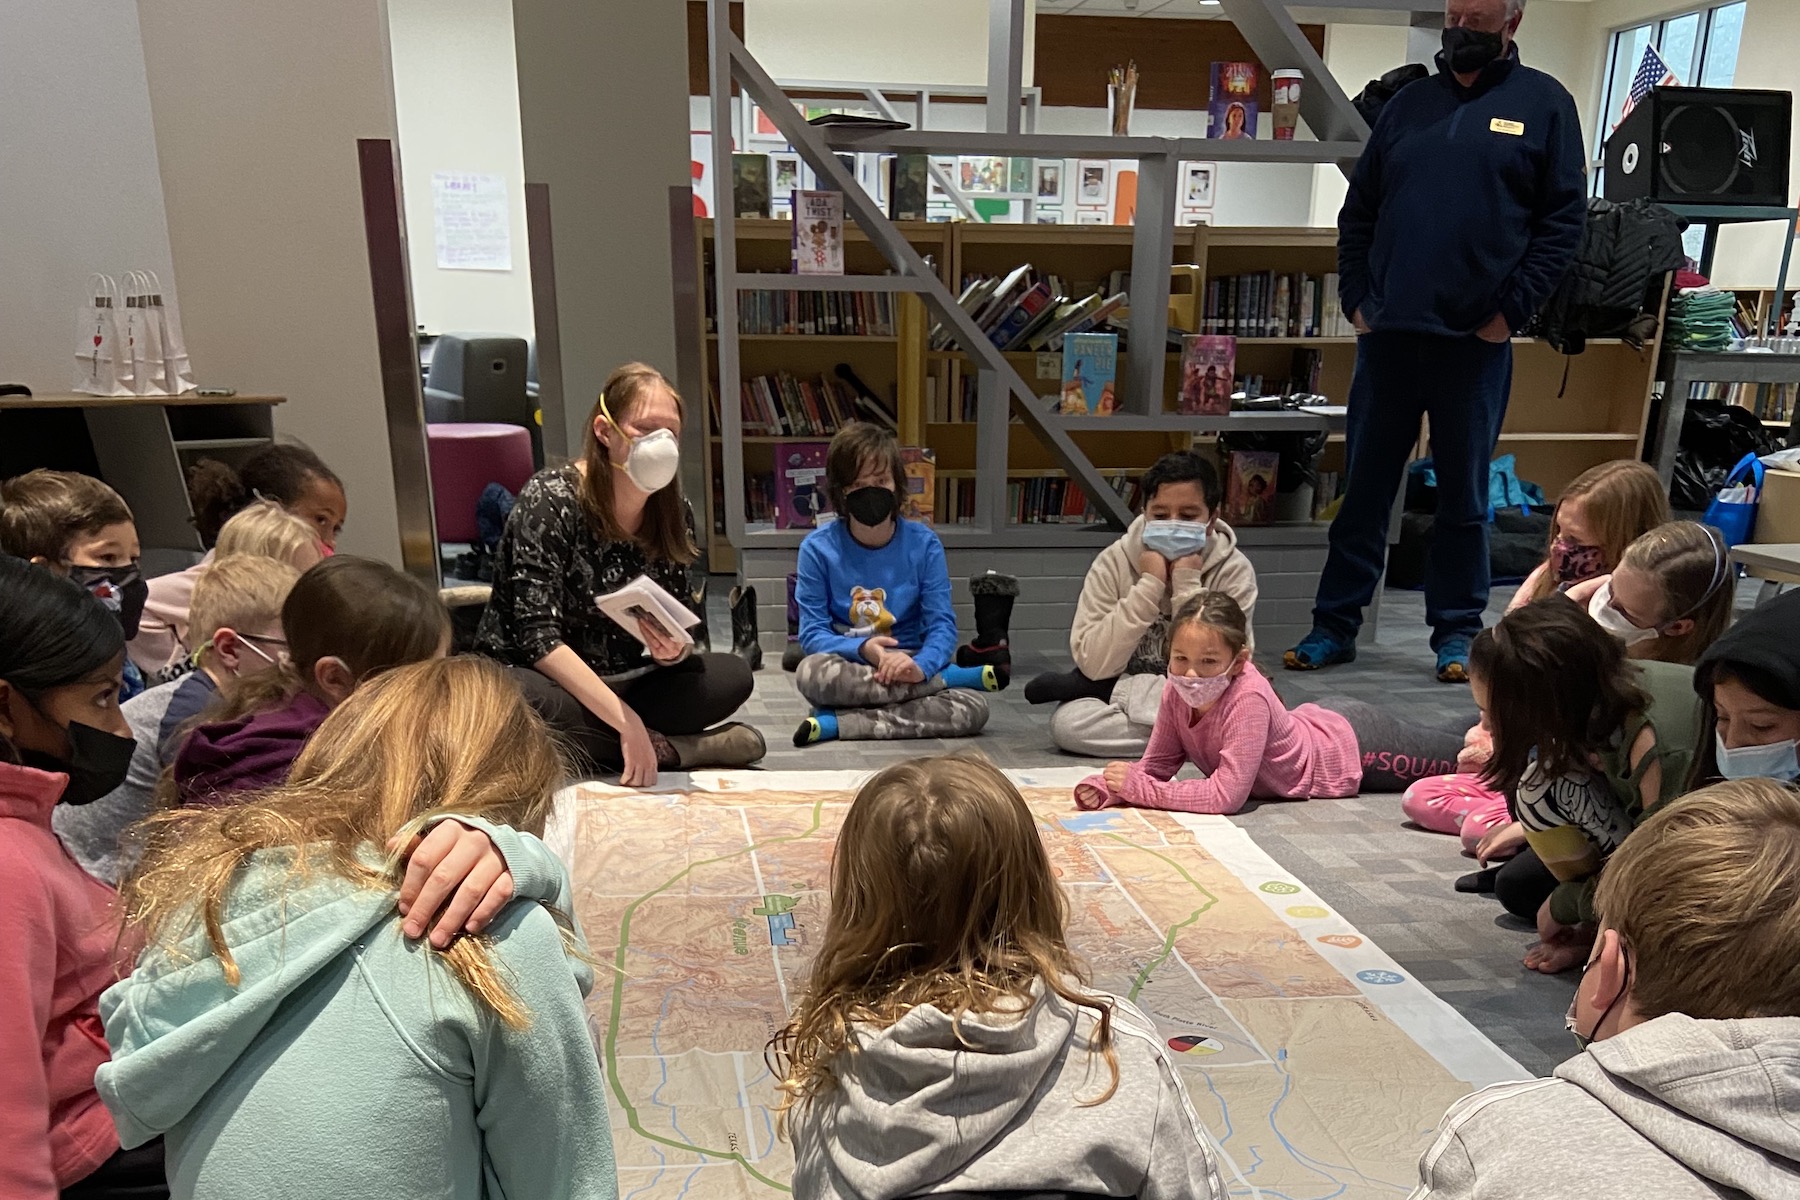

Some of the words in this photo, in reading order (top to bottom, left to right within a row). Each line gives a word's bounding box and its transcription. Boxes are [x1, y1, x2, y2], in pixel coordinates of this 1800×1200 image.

[810, 198, 828, 207] ADA
[805, 207, 833, 217] TWIST
[1196, 1022, 1218, 1030] River
[728, 1132, 740, 1151] TEXAS
